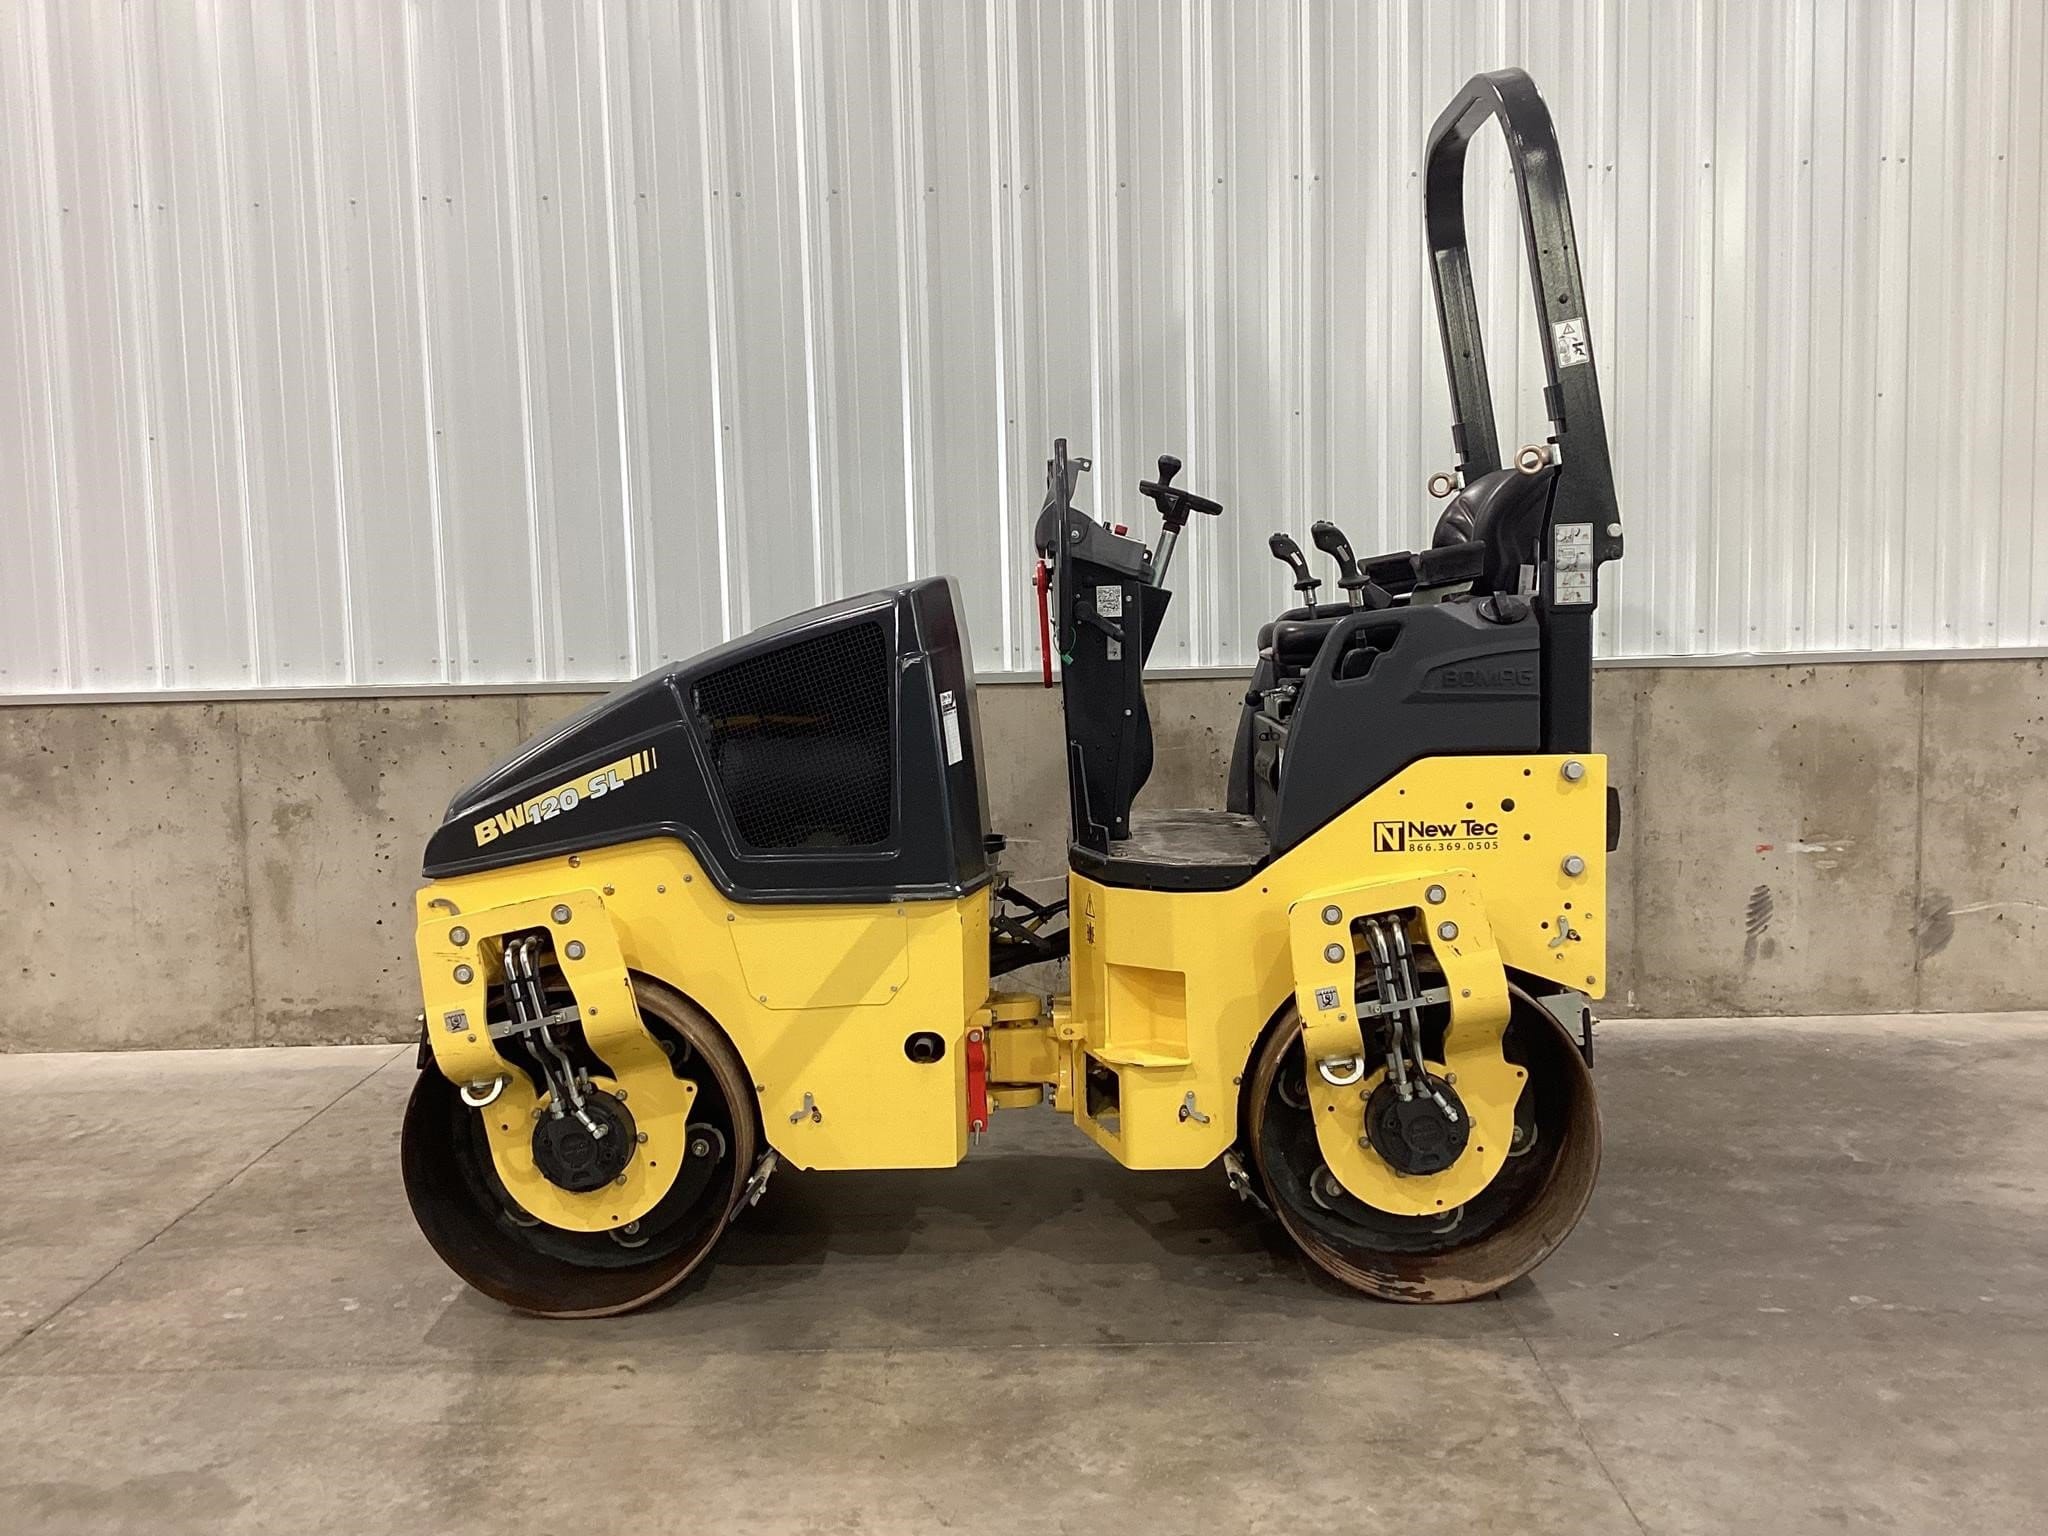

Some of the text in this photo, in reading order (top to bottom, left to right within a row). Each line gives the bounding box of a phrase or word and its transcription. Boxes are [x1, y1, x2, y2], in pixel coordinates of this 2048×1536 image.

[1442, 668, 1536, 688] BOMAG
[588, 768, 625, 800] SL
[1408, 820, 1499, 838] New Tec
[1408, 841, 1499, 852] 866.369.0505
